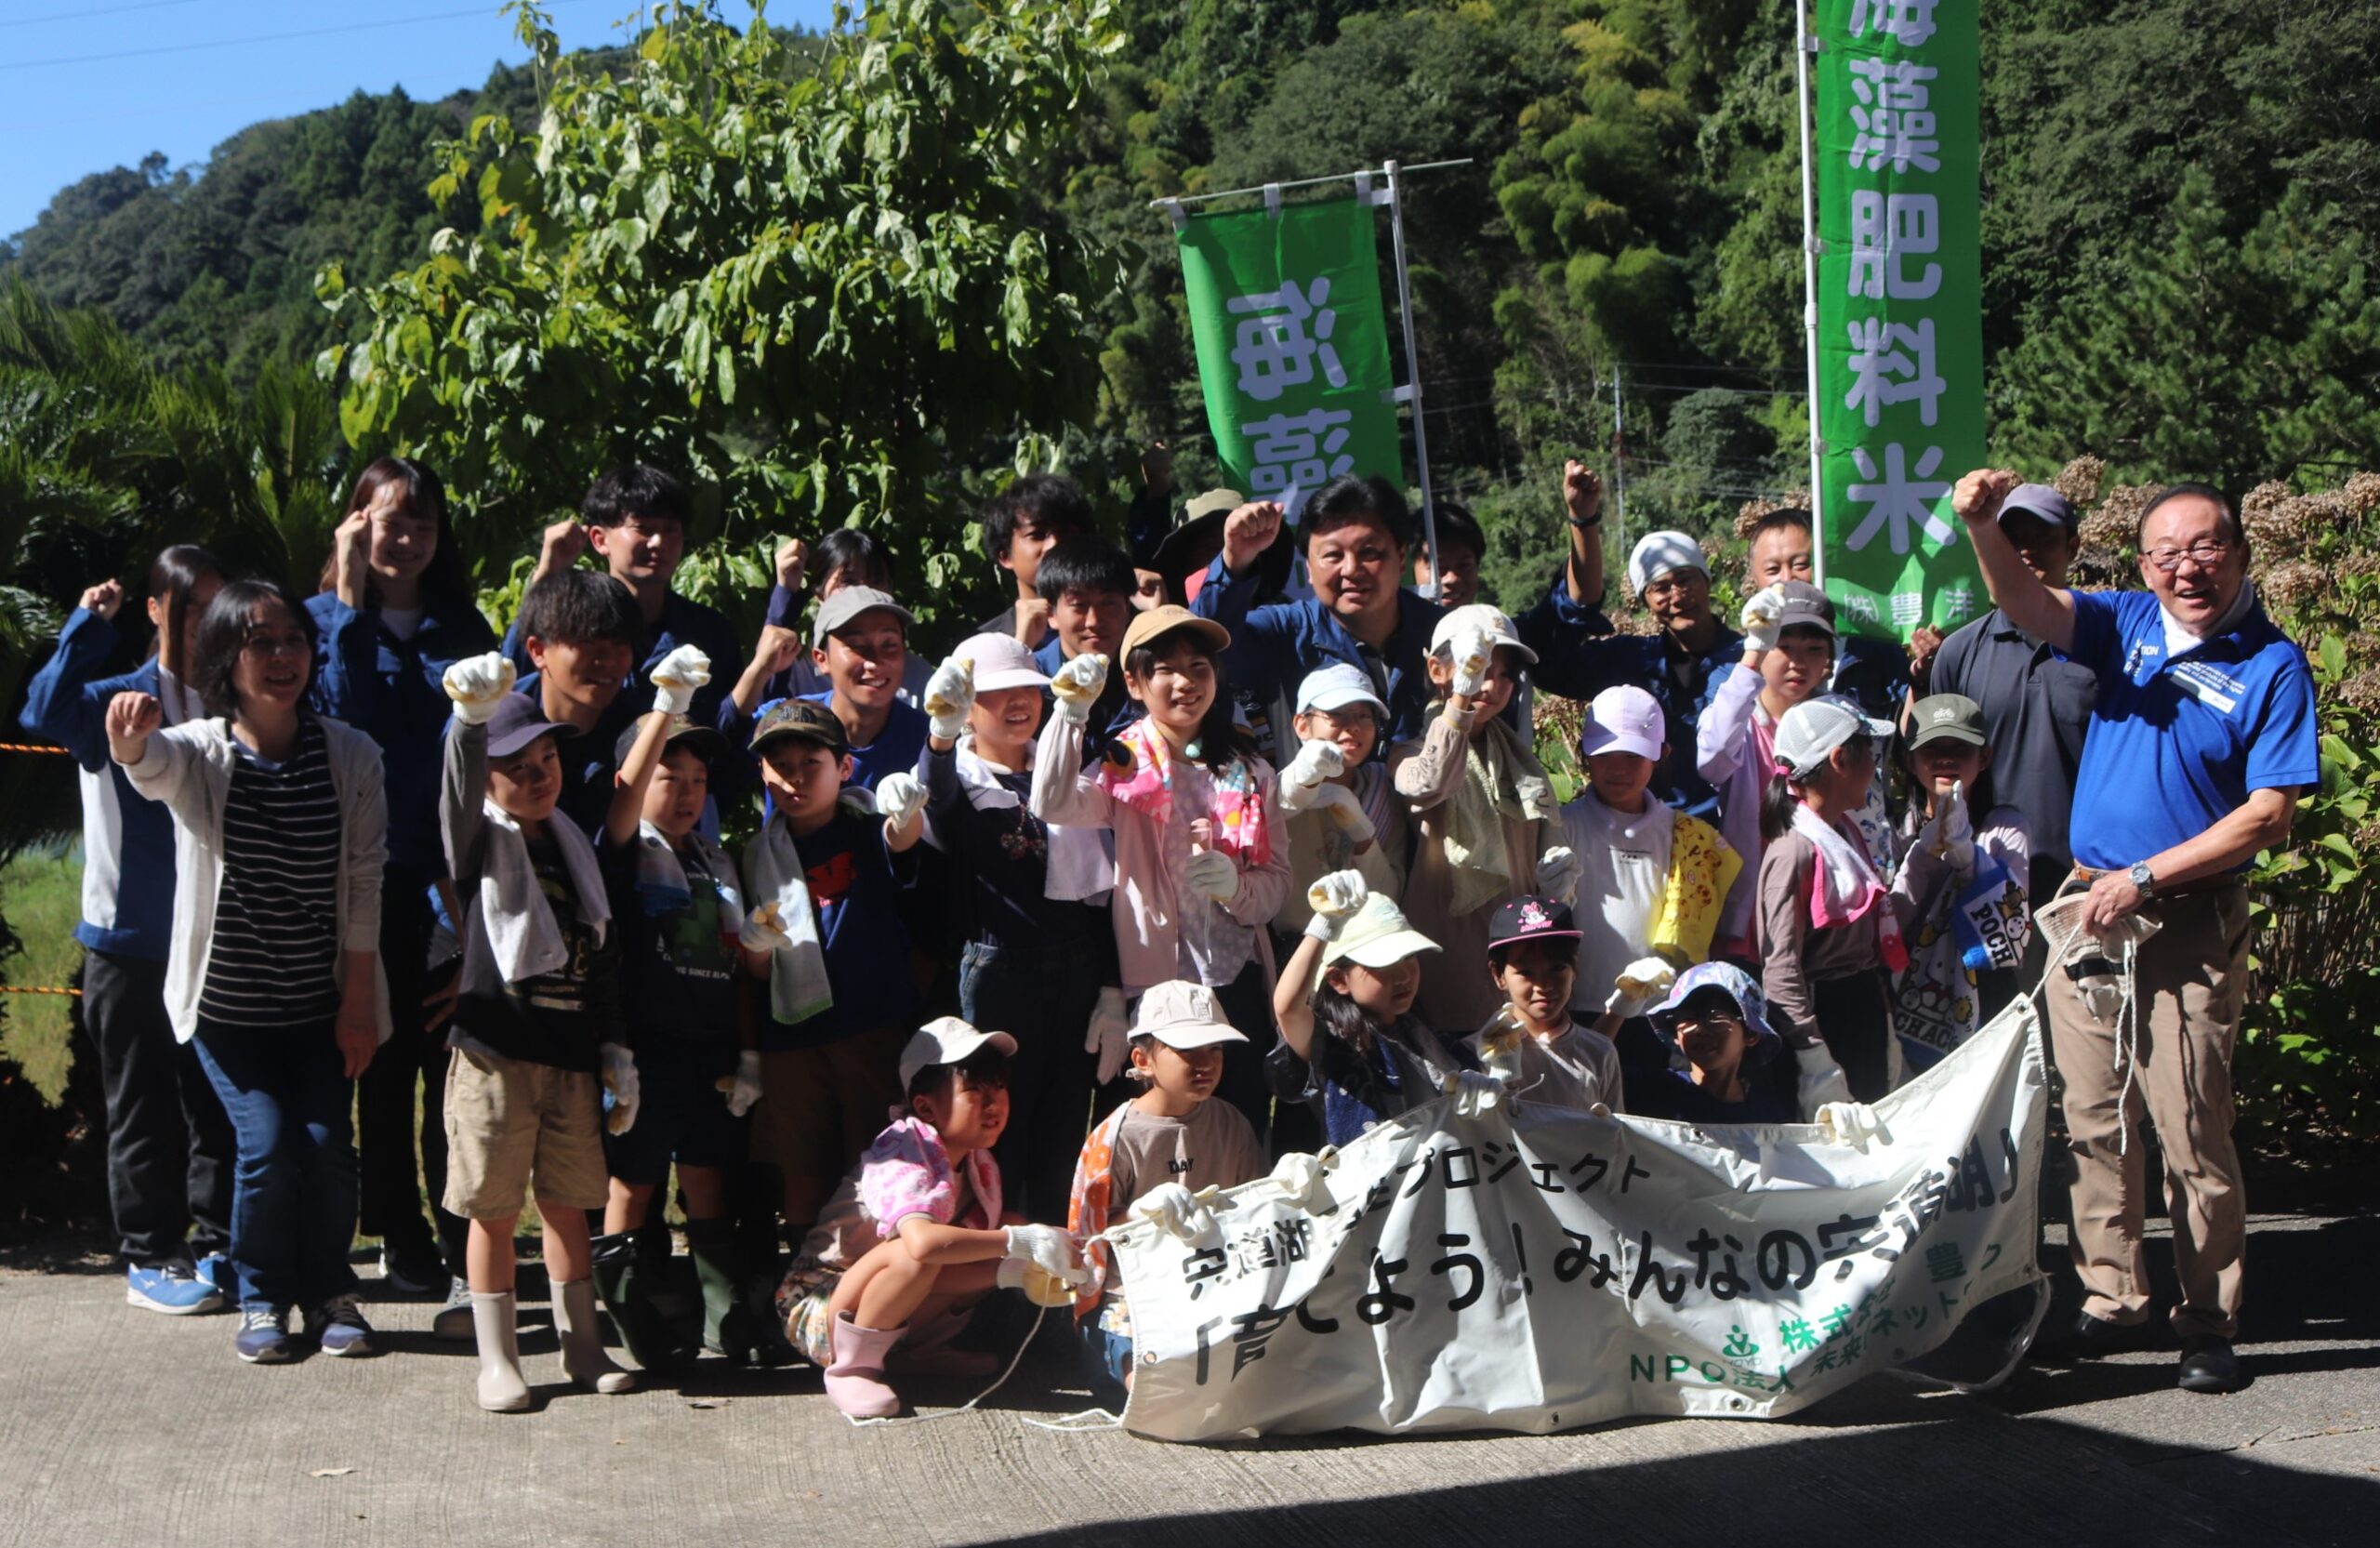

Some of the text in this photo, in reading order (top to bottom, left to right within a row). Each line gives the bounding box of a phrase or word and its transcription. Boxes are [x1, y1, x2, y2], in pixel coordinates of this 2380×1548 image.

[1970, 903, 2014, 965] POCH
[1169, 1158, 1195, 1174] DAY
[1182, 1142, 1651, 1301] 宍道湖プロジェクト
